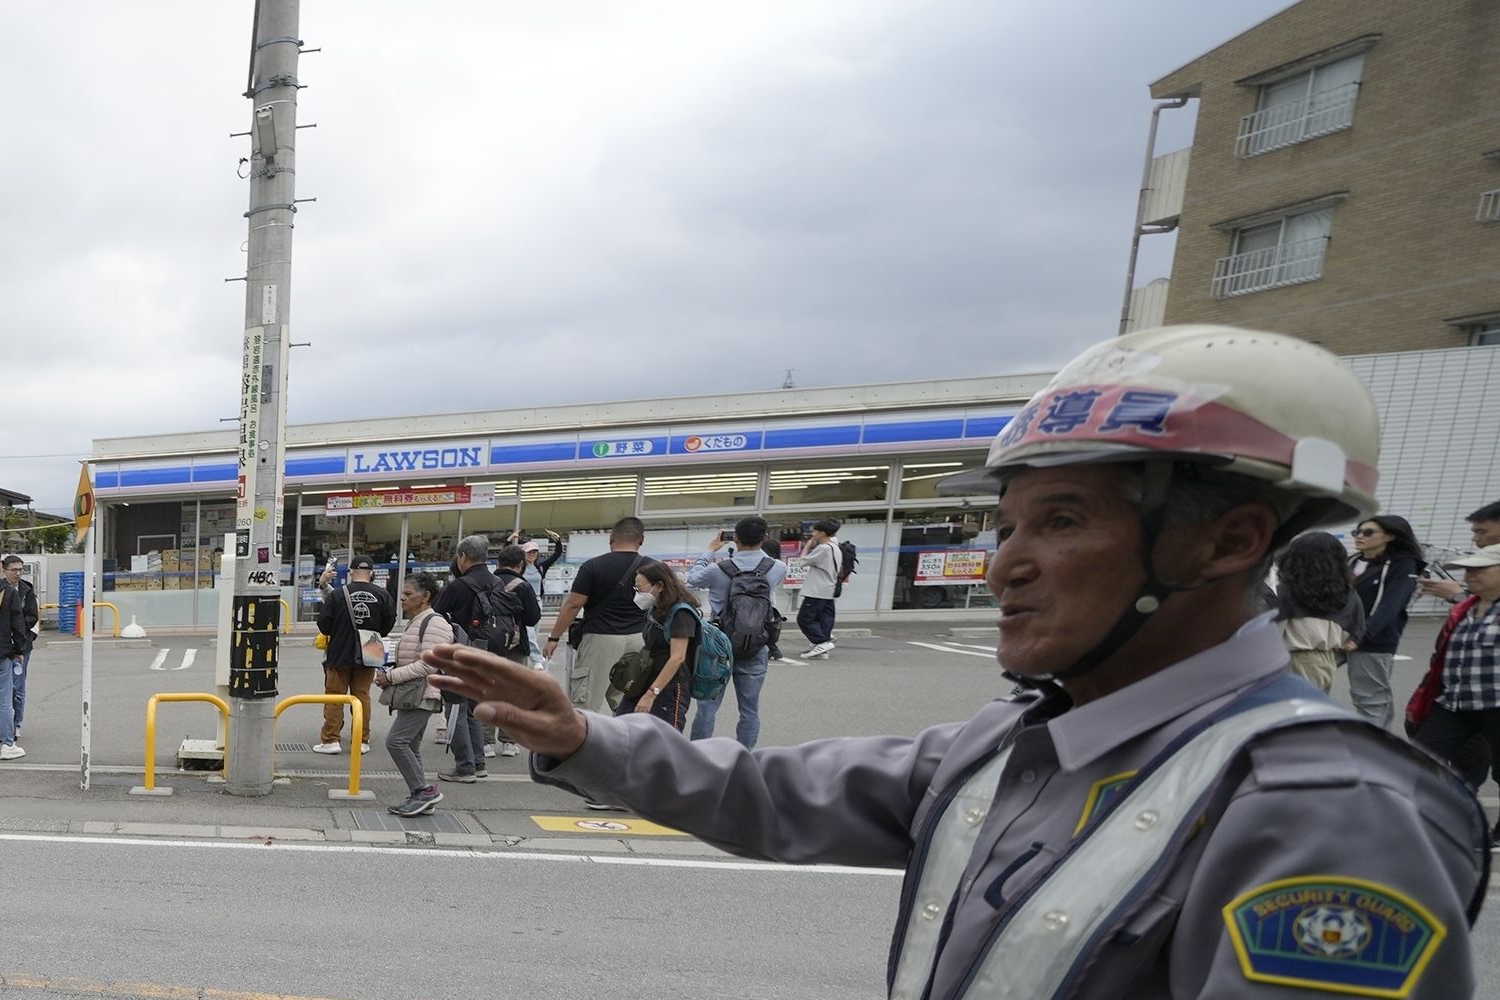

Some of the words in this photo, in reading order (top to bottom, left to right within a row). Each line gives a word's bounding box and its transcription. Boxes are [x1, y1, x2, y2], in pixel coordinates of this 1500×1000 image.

[614, 442, 645, 454] 野菜
[704, 436, 743, 449] くだもの
[354, 447, 481, 473] LAWSON
[1252, 889, 1351, 920] SECURITY
[1356, 895, 1417, 934] GUARD
